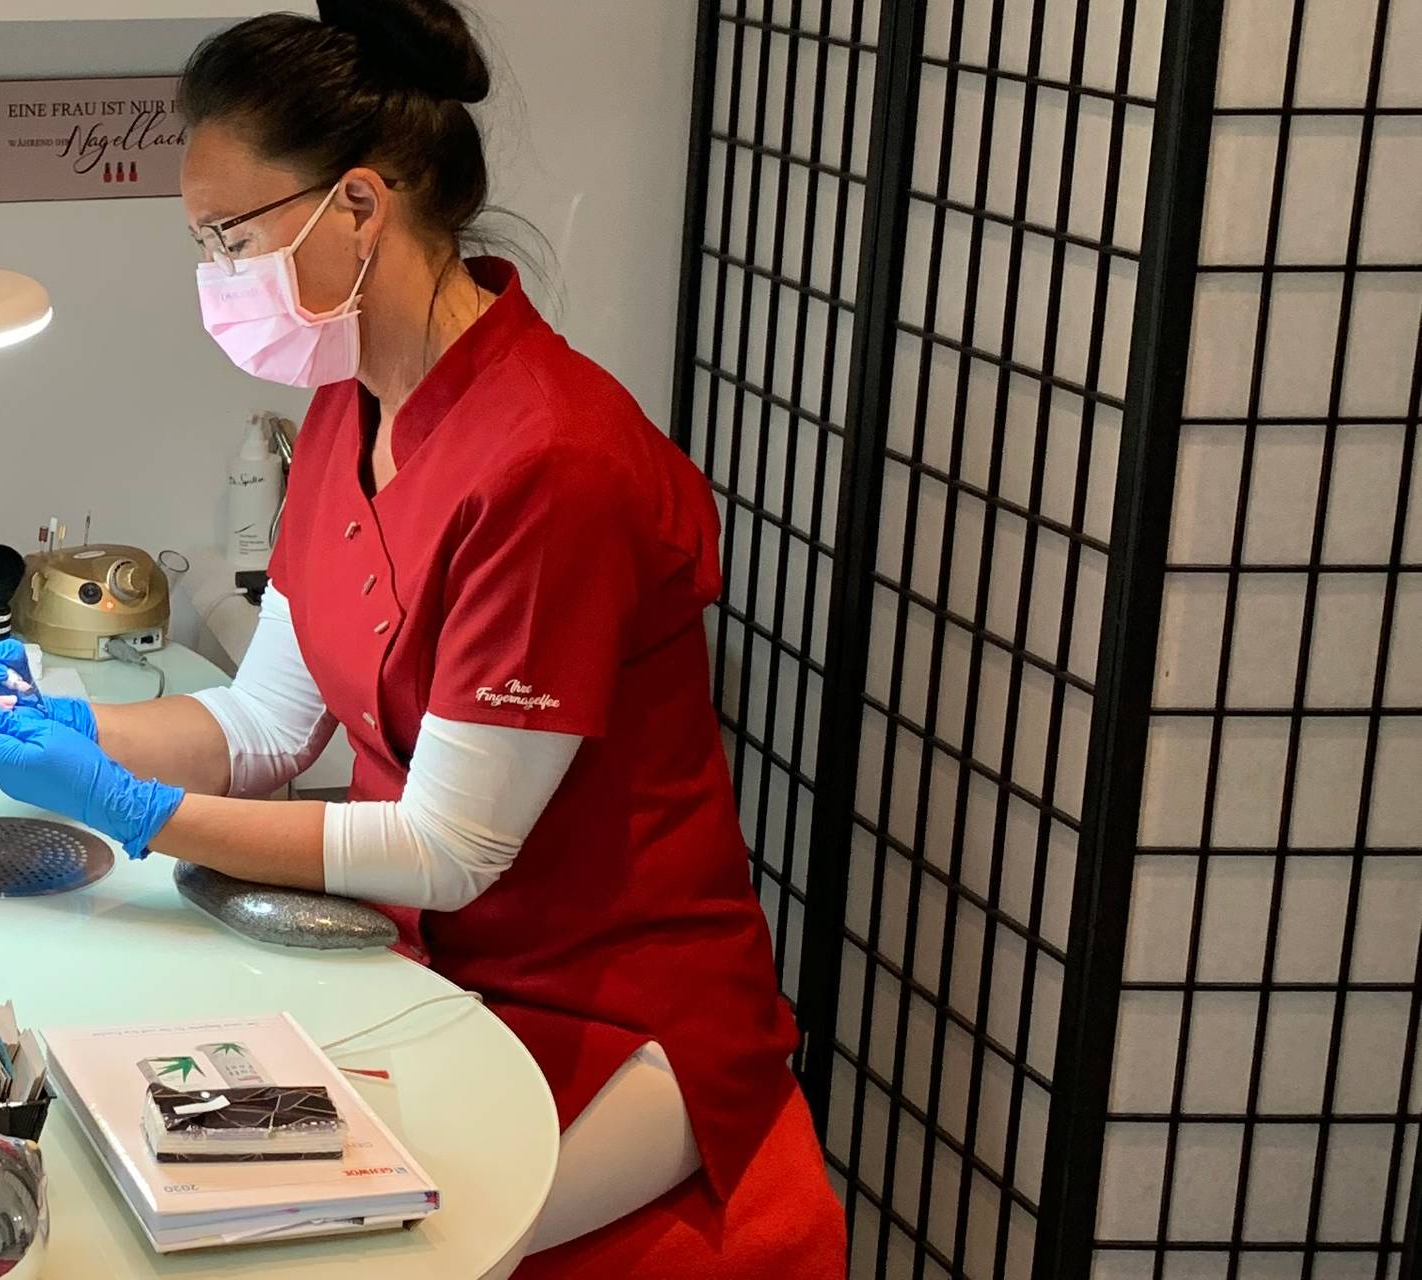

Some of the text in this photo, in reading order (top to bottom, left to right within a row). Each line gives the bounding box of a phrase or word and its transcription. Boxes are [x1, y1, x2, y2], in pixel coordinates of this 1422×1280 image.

[8, 103, 47, 118] EINE
[52, 101, 96, 117] FRAU
[101, 101, 126, 116] IST
[130, 100, 165, 114] NUR
[163, 1184, 200, 1193] 2020
